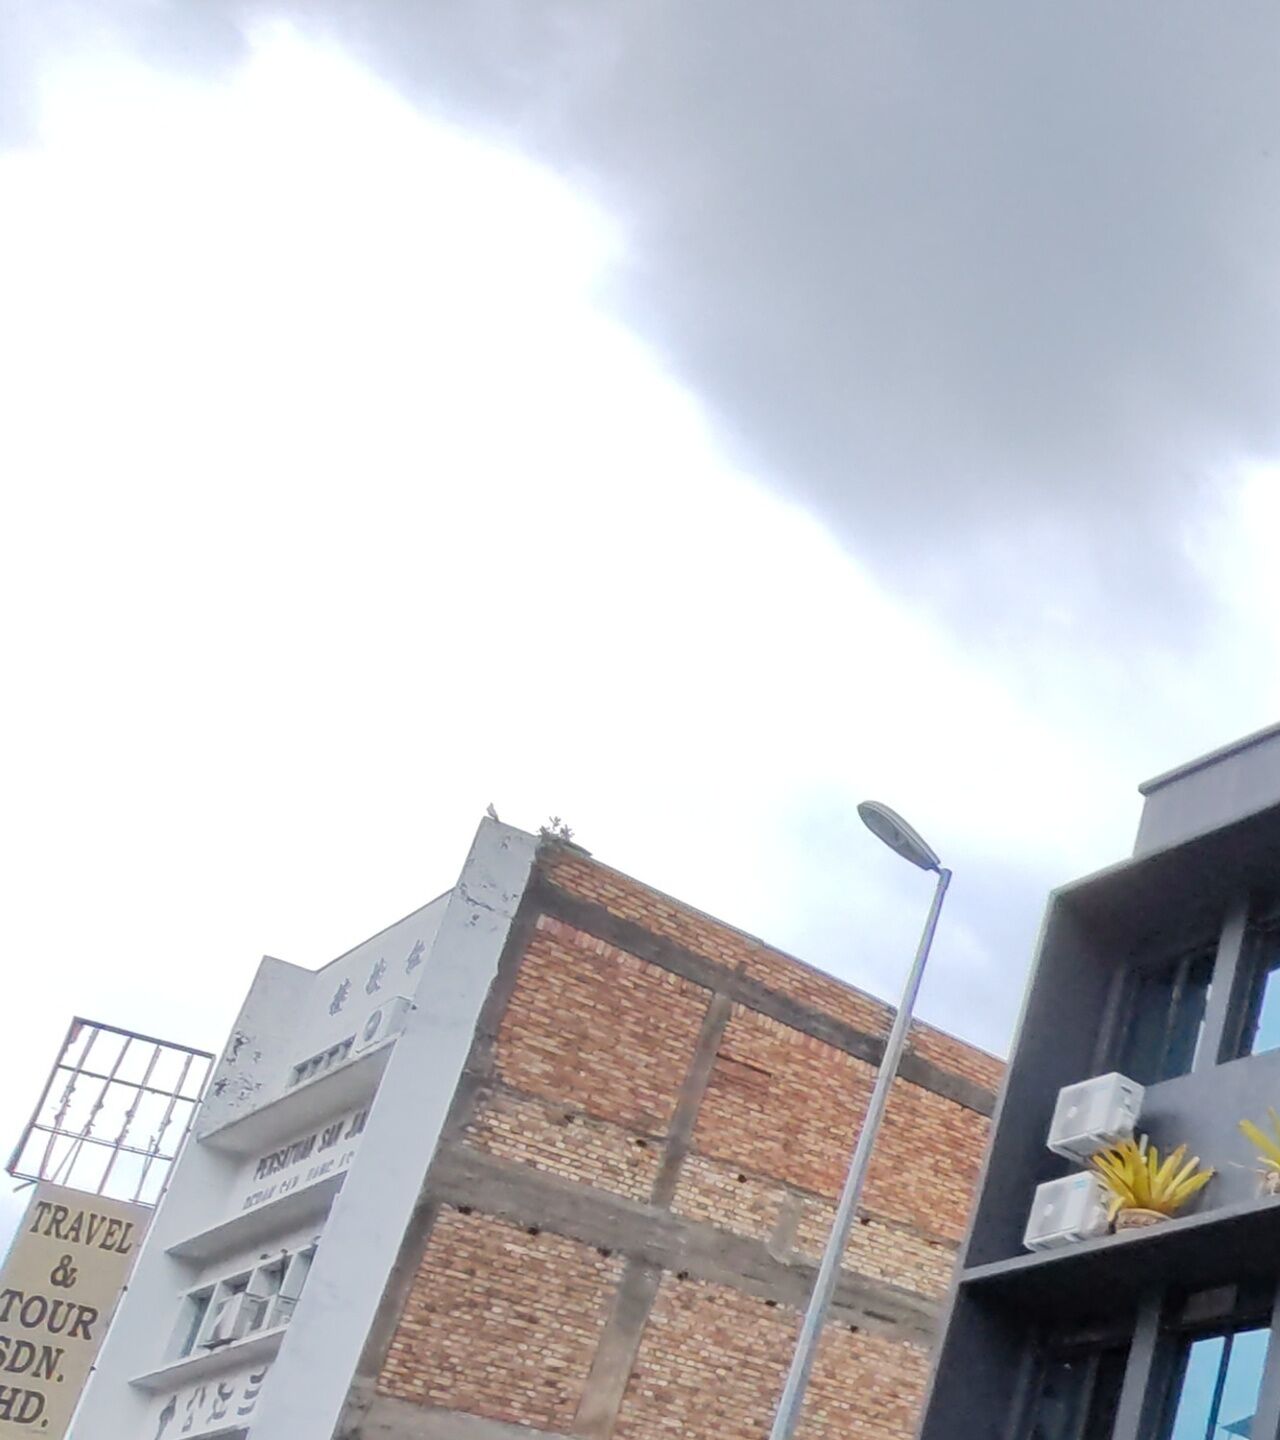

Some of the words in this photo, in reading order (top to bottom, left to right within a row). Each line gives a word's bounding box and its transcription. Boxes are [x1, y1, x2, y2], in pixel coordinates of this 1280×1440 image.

[29, 1200, 134, 1255] TRAVEL
[50, 1254, 77, 1288] &
[0, 1288, 98, 1340] TOUR
